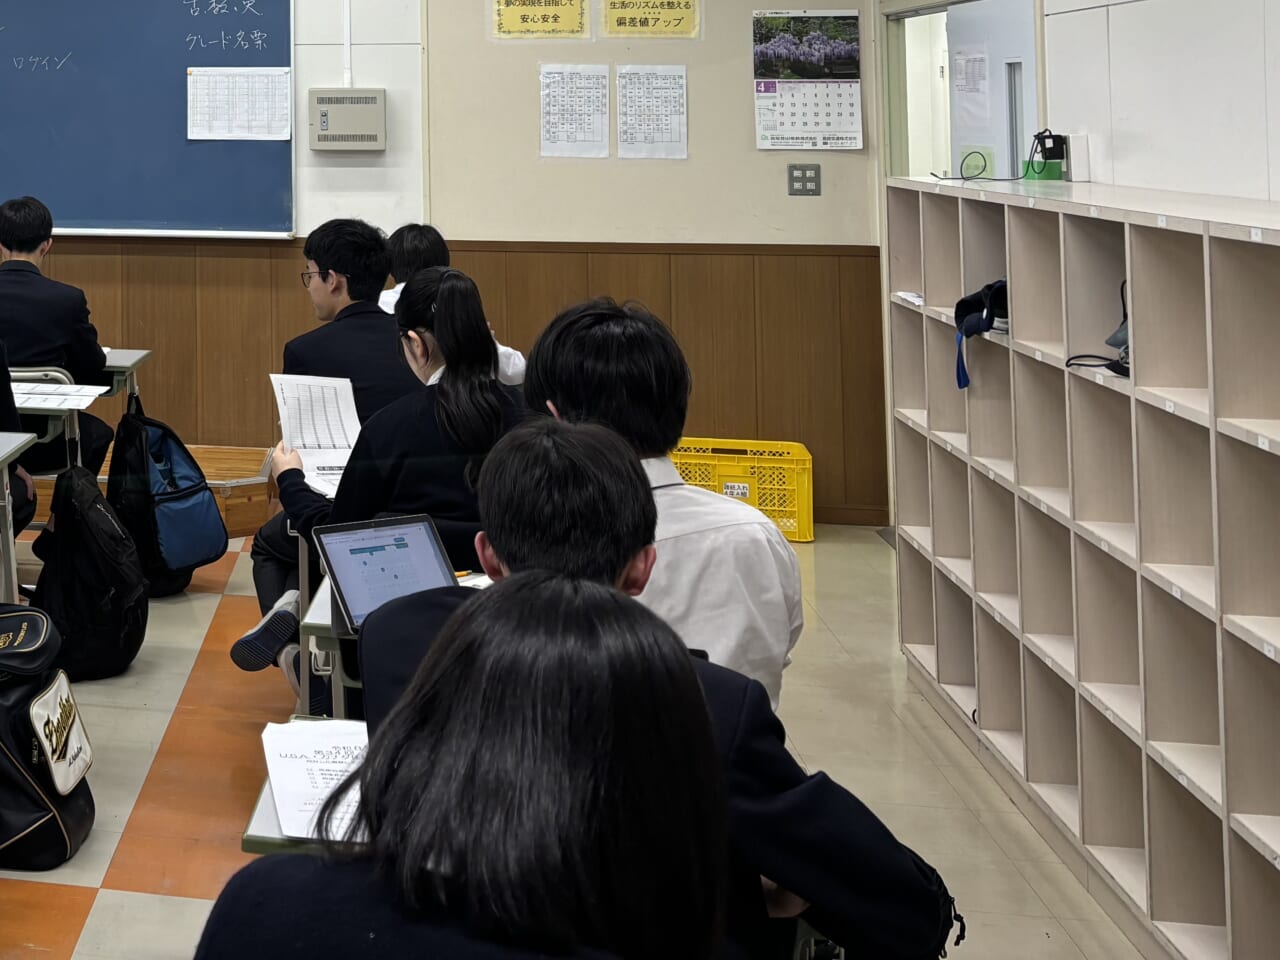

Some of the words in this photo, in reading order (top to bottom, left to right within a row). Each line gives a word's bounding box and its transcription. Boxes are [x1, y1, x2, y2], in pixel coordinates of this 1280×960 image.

[609, 0, 692, 10] 生活のリズムを整える
[520, 13, 561, 24] 安心安全
[616, 16, 685, 28] 偏差値アップ
[185, 29, 268, 51] グレード名票
[757, 82, 765, 92] 4
